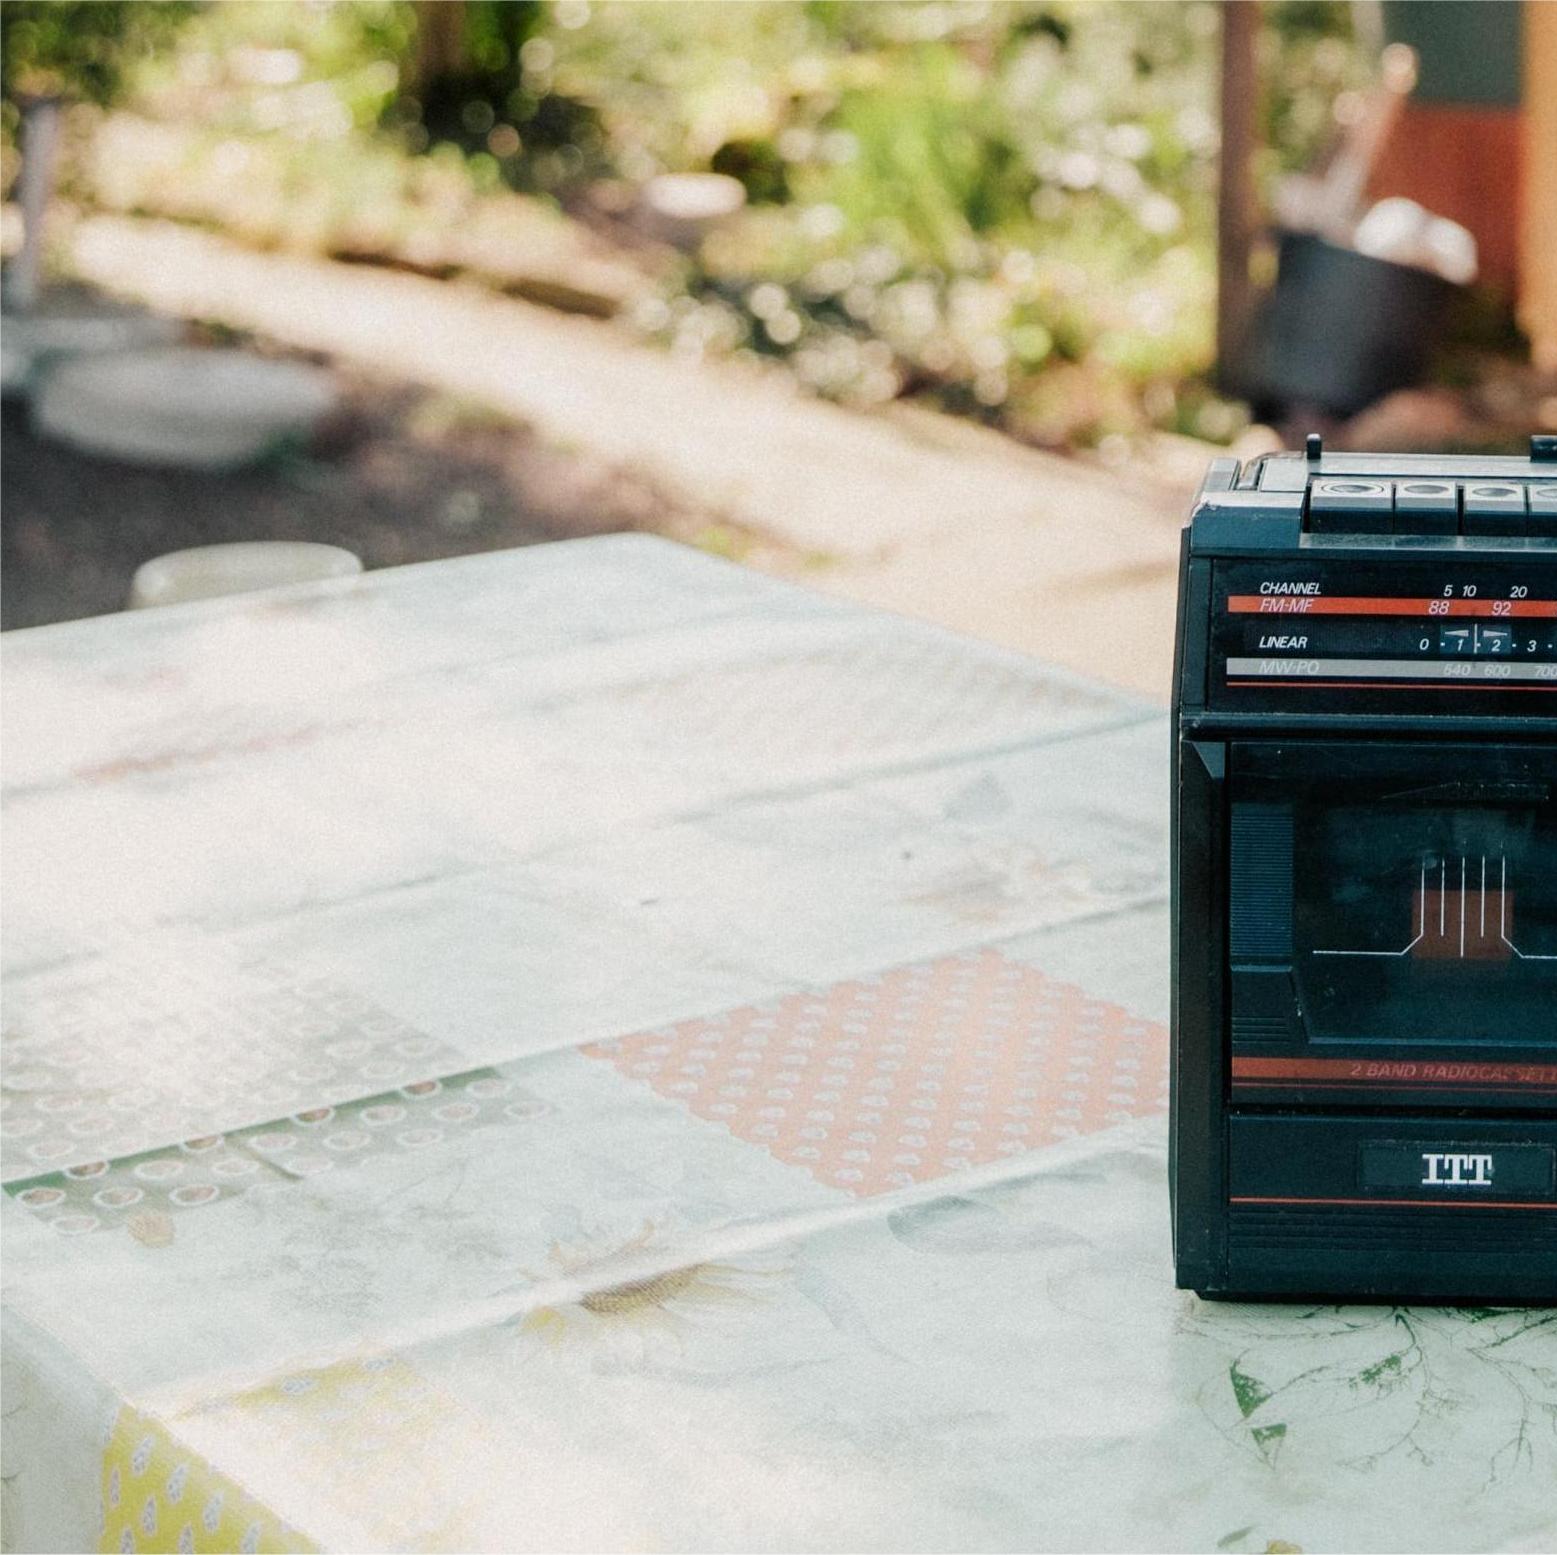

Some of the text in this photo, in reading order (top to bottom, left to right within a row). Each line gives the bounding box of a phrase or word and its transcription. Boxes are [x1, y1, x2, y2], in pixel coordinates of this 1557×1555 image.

[1260, 581, 1322, 595] CHANNEL
[1443, 584, 1453, 597] 5
[1462, 585, 1477, 597] 10
[1510, 585, 1528, 598] 20
[1260, 598, 1314, 613] FM-MF
[1428, 600, 1450, 615] 88
[1492, 601, 1512, 616] 92
[1259, 636, 1308, 649] LINEAR
[1419, 638, 1430, 651] 0
[1457, 638, 1465, 651] 1
[1492, 639, 1501, 652] 2
[1527, 639, 1537, 653] 3
[1443, 663, 1471, 677] 540
[1484, 664, 1511, 677] 600
[1351, 1063, 1362, 1077] 2
[1366, 1063, 1417, 1078] BAND
[1422, 1153, 1493, 1185] ITT
